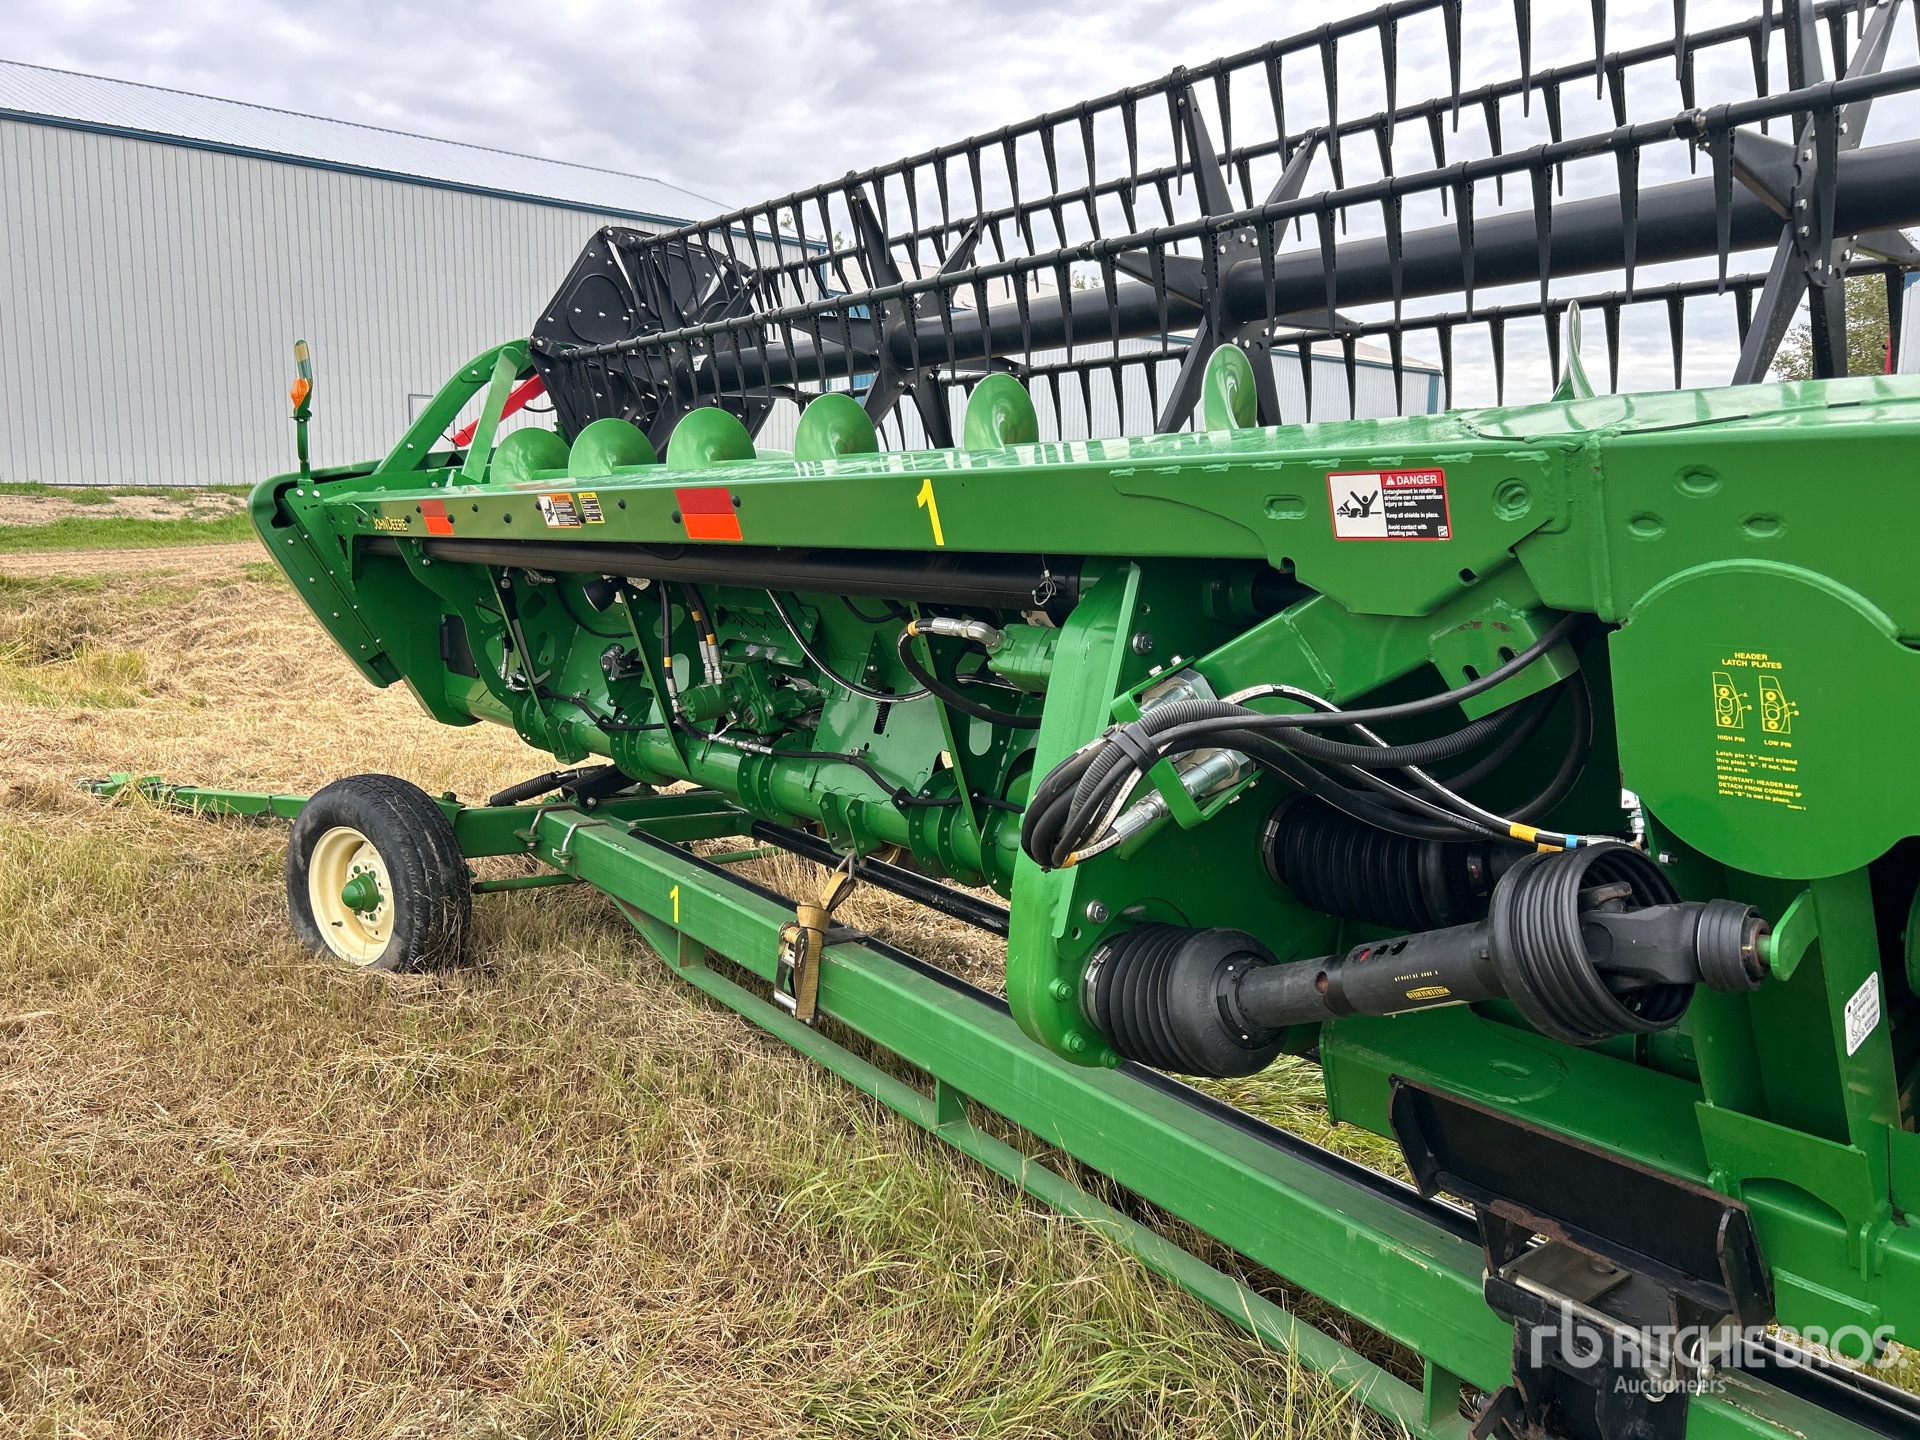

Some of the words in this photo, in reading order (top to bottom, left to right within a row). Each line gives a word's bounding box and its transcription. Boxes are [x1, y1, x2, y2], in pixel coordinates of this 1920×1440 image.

[1396, 474, 1438, 486] DANGER
[916, 478, 944, 546] 1
[1734, 652, 1768, 660] HEADER
[1722, 658, 1748, 667] LATCH
[1751, 660, 1782, 670] PLATES
[1776, 757, 1798, 765] extend
[1718, 774, 1756, 784] IMPORTANT:
[1756, 780, 1783, 788] HEADER
[1784, 782, 1798, 790] MAY
[1718, 782, 1743, 790] DETACH
[1764, 788, 1794, 796] COMBINE
[670, 884, 678, 924] 1
